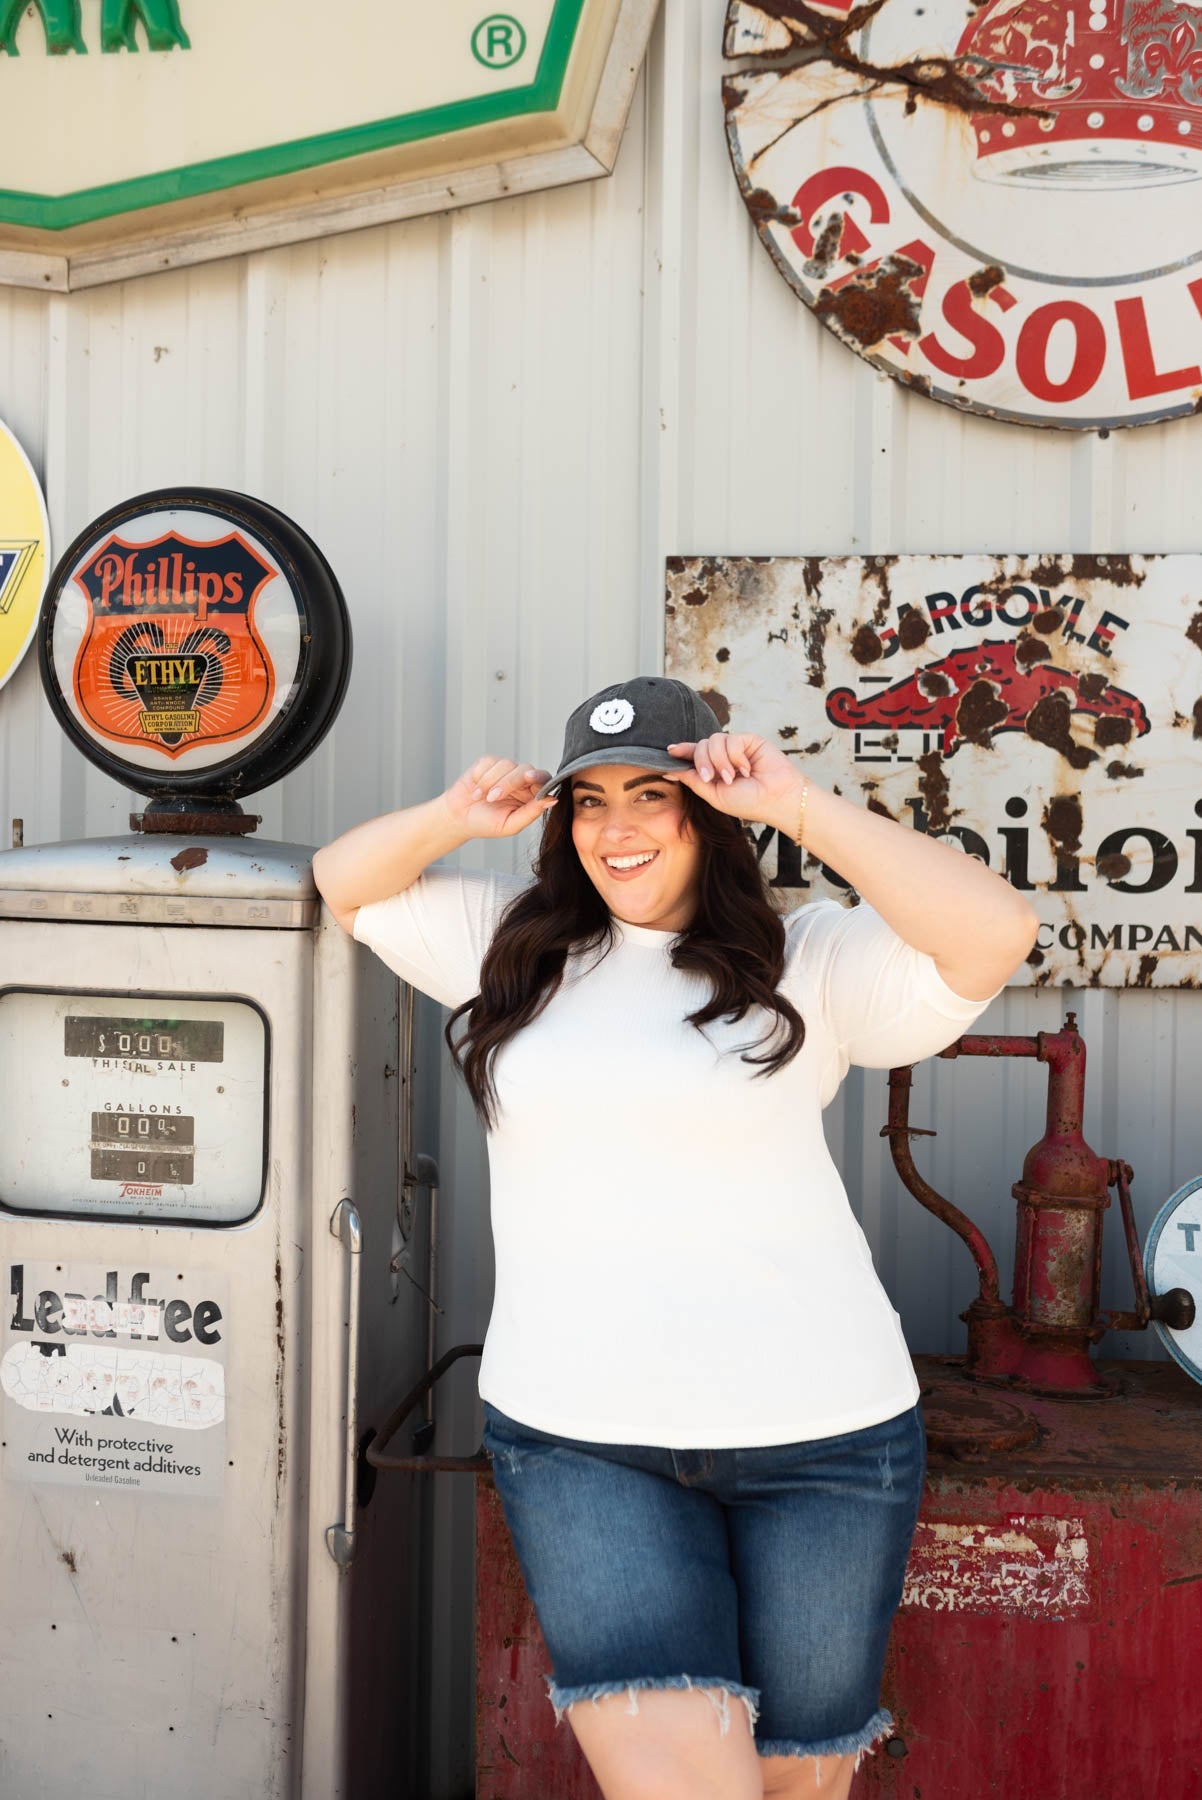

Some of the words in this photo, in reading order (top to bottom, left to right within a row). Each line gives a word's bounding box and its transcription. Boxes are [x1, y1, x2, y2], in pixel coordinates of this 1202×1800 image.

[790, 166, 1202, 402] GASOL
[94, 552, 243, 621] Phillips
[134, 659, 200, 685] ETHYL
[143, 713, 164, 721] ETHYL
[164, 713, 195, 721] GASOLINE
[157, 1062, 196, 1072] SALE
[104, 1102, 182, 1114] GALLONS
[119, 1183, 163, 1198] TOKHEIM
[54, 1427, 93, 1447] With
[97, 1438, 173, 1454] protective
[27, 1447, 54, 1463] and
[57, 1448, 130, 1471] detergent
[133, 1455, 201, 1476] additives
[114, 1475, 141, 1486] Gasoline
